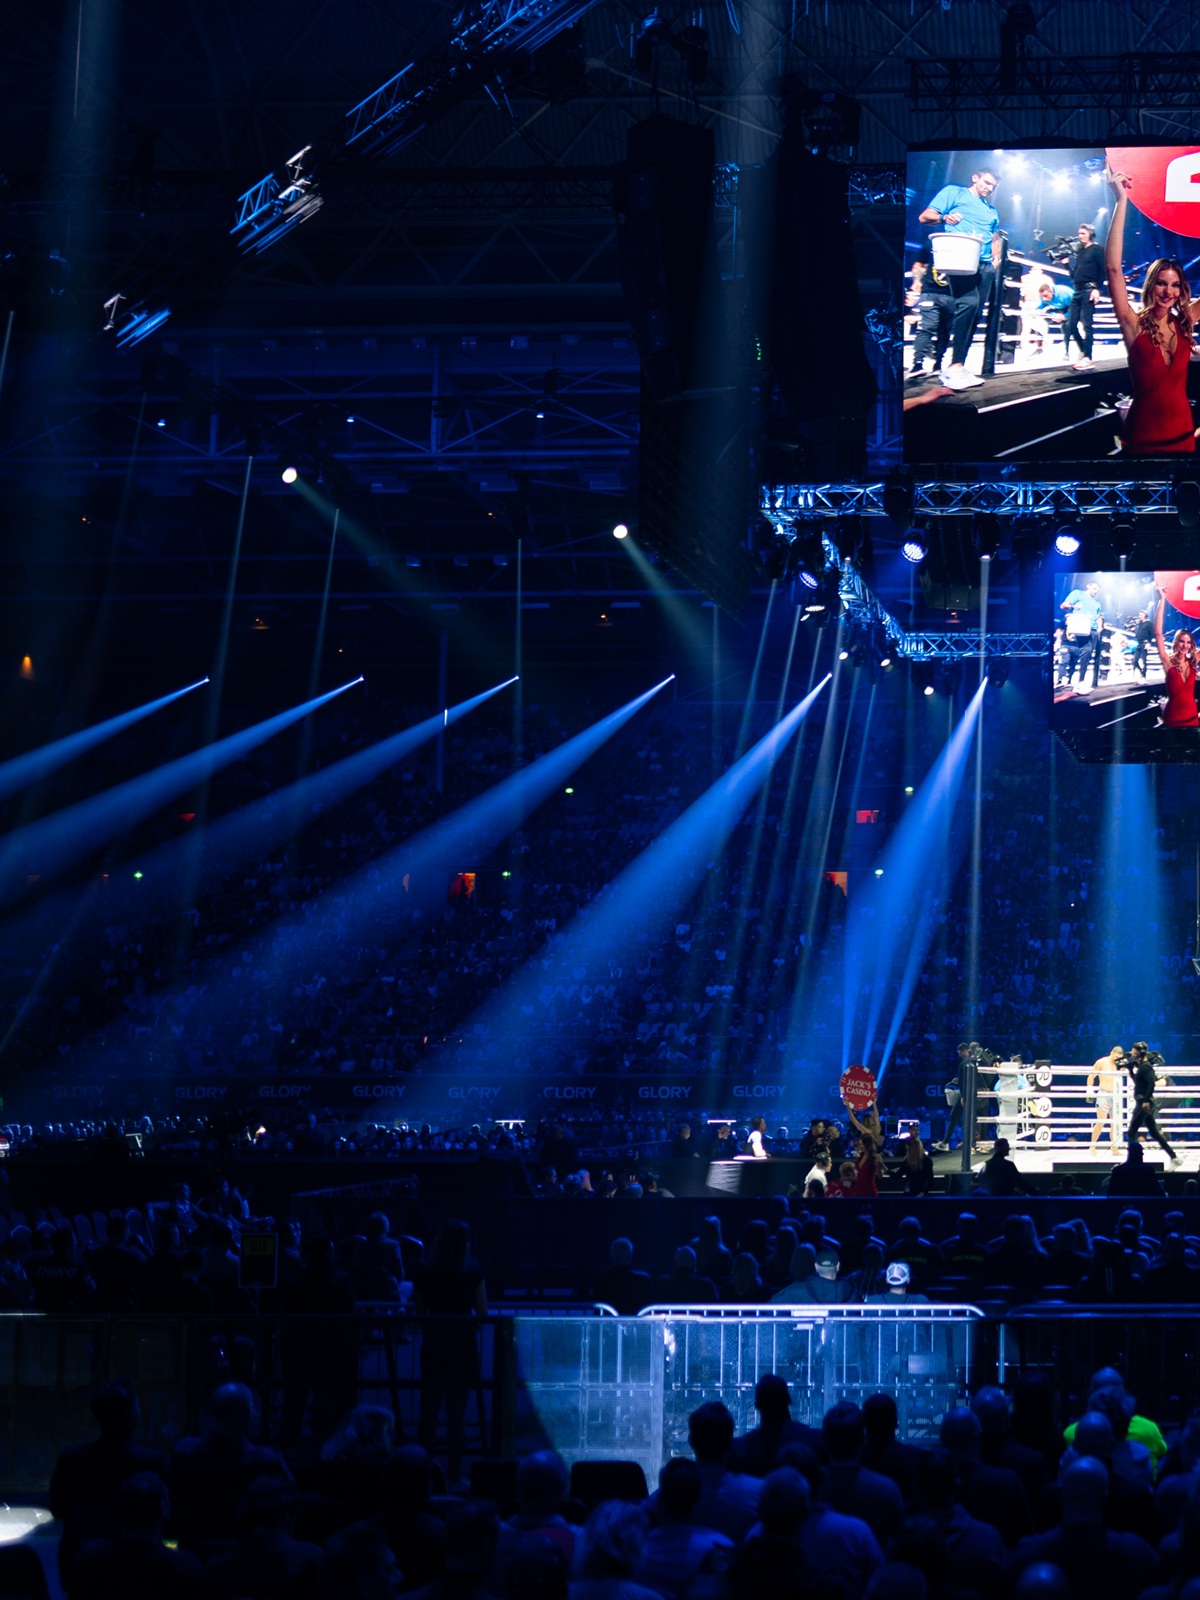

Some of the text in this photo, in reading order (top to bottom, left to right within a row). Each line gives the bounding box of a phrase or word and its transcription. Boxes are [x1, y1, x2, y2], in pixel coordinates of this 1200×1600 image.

[847, 1079, 871, 1090] JACK'S
[175, 1086, 228, 1099] GLORY
[353, 1085, 406, 1098] GLORY
[638, 1086, 692, 1099] GLORY
[733, 1085, 786, 1097] GLORY
[846, 1086, 871, 1097] CASINO
[1038, 1131, 1049, 1140] JD
